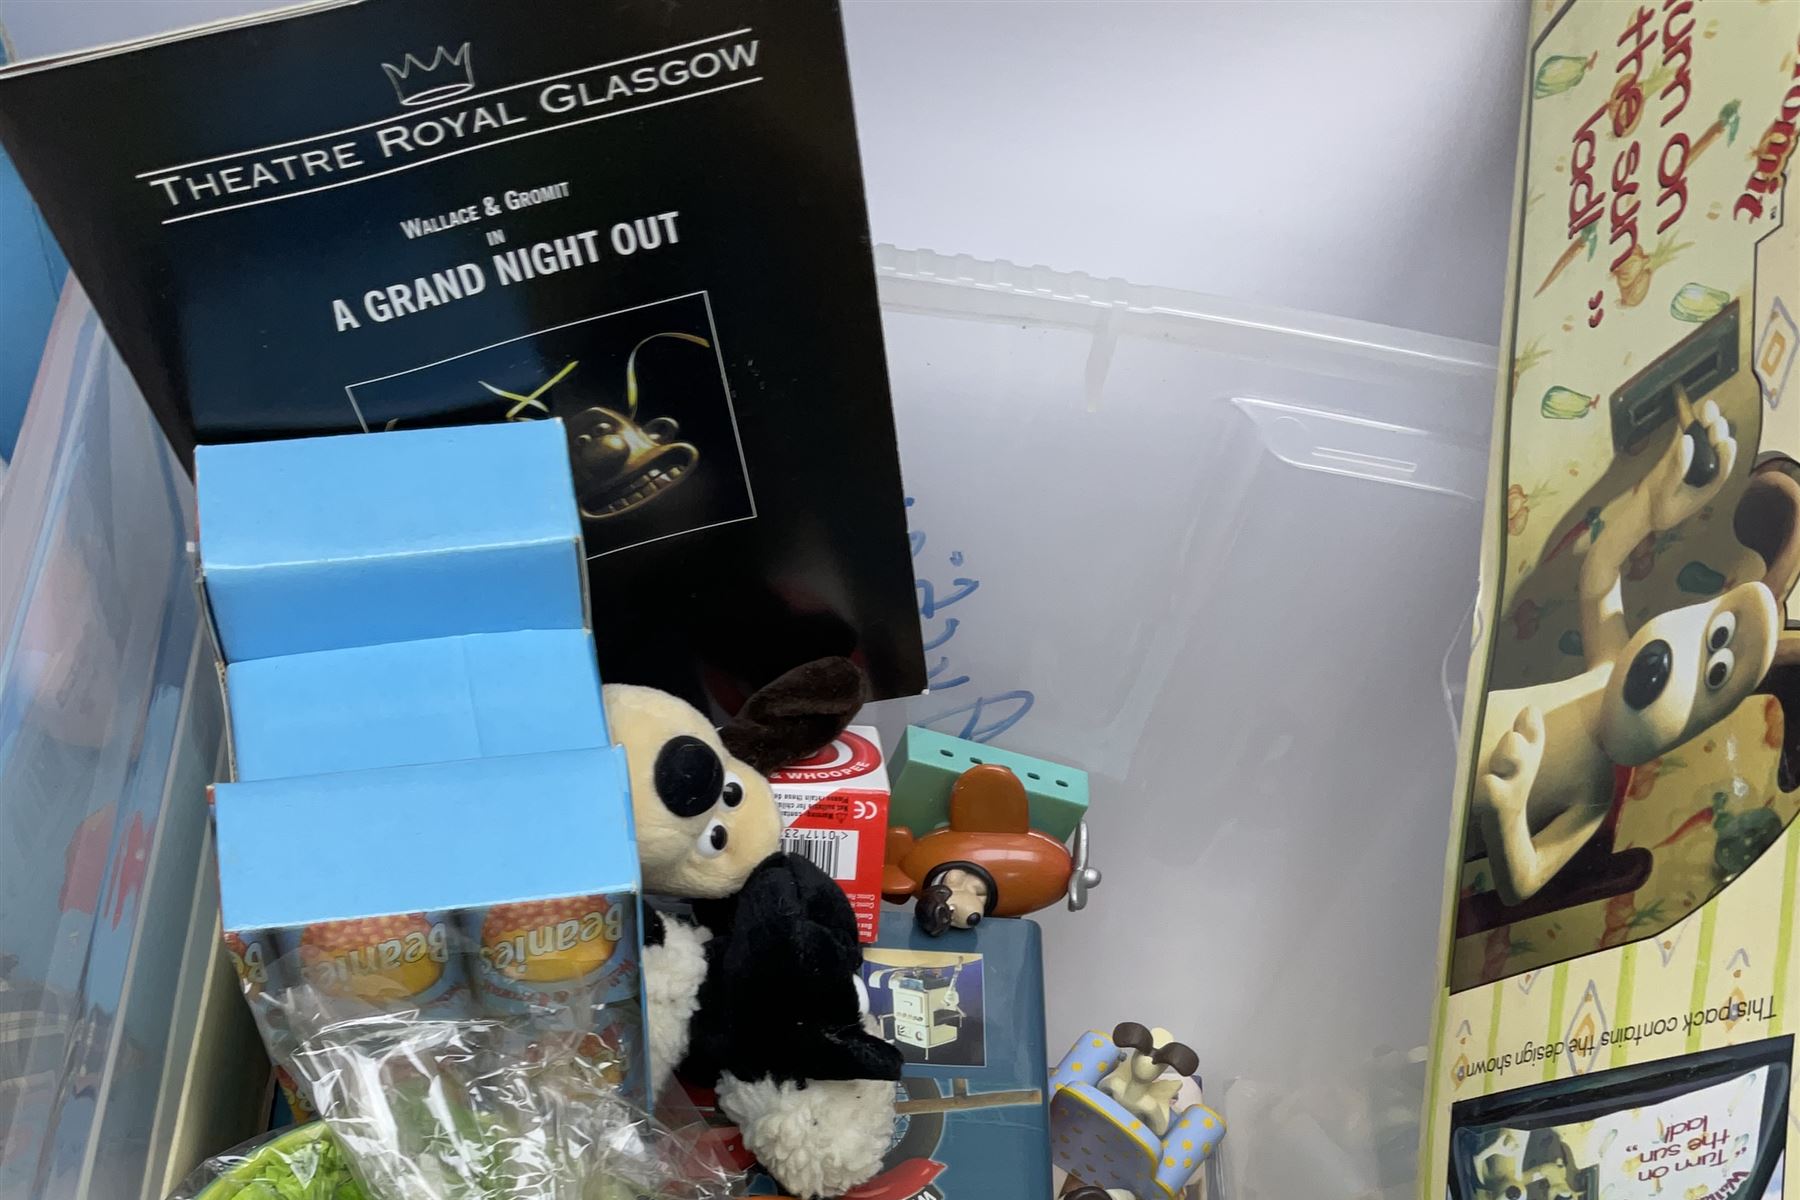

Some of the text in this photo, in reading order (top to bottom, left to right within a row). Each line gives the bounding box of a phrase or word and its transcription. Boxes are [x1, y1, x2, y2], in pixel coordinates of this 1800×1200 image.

[150, 40, 760, 208] THEATRE ROYAL GLASGOW
[1657, 0, 1696, 235] urn on
[483, 195, 502, 218] &
[1610, 141, 1641, 271] sun
[332, 212, 682, 332] A GRAND NIGHT OUT
[785, 761, 870, 780] WHOOPEE
[805, 828, 835, 840] 0117
[480, 902, 625, 972] Beanies
[1466, 995, 1777, 1080] This pack contains the design shown
[1638, 1149, 1728, 1181] Turn on
[1640, 1129, 1729, 1163] the sun
